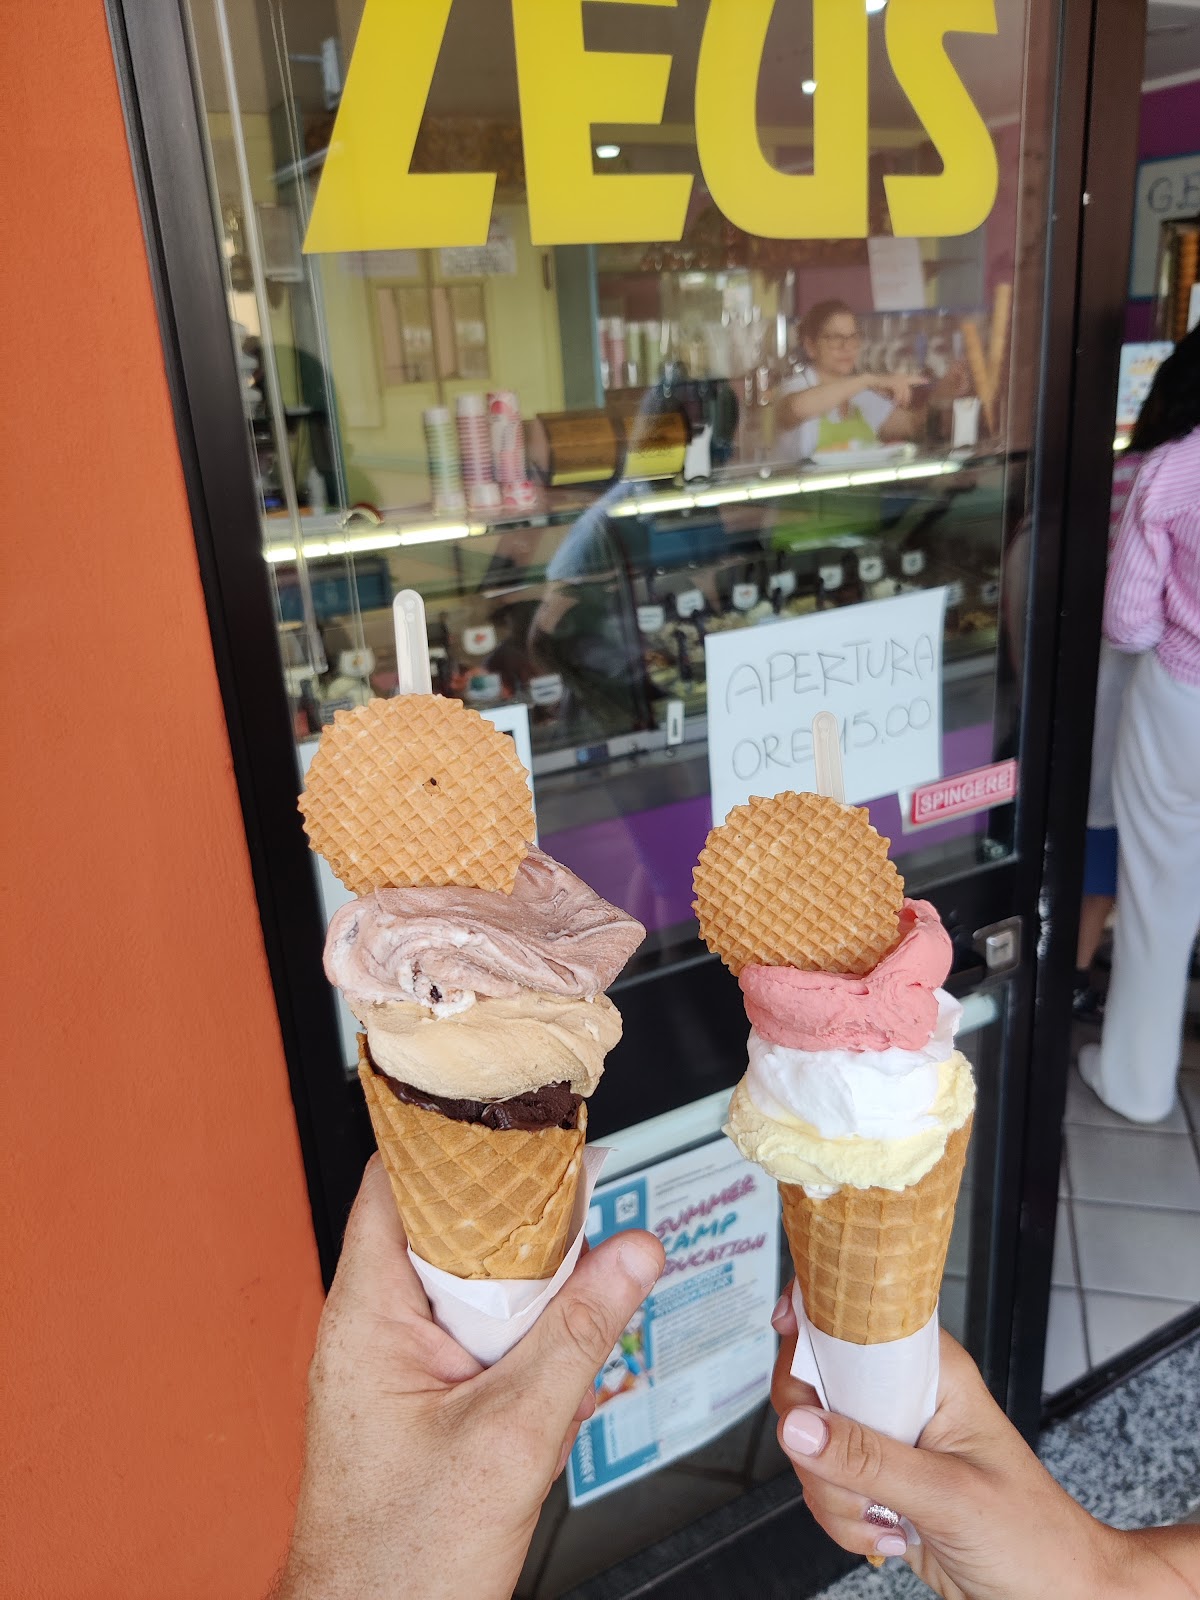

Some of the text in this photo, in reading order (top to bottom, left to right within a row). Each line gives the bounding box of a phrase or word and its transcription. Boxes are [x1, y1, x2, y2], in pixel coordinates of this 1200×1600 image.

[726, 633, 934, 714] APERTURA
[732, 696, 931, 781] ORE 15.00
[919, 772, 1011, 816] SPINGERE
[655, 1174, 757, 1240] SUMMER
[660, 1232, 768, 1279] DUCATION
